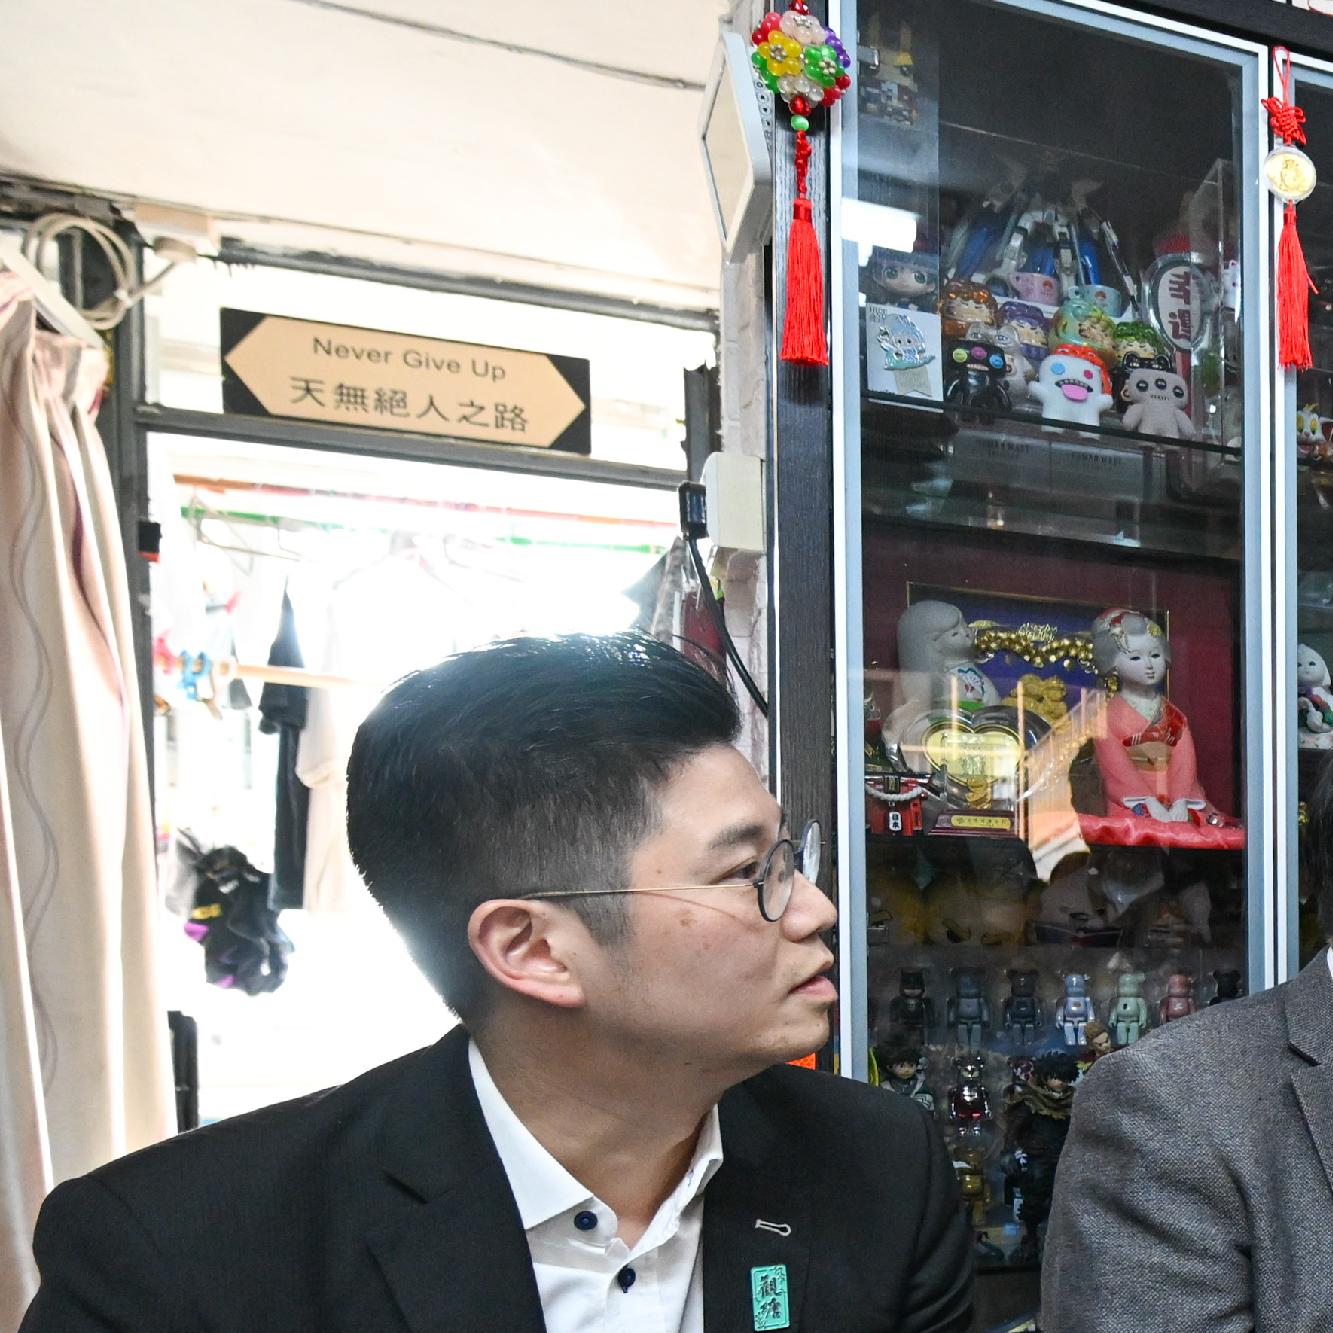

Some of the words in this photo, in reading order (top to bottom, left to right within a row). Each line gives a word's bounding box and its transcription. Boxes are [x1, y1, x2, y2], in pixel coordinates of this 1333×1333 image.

[312, 336, 393, 364] Never
[402, 350, 461, 374] Give
[471, 358, 507, 383] Up
